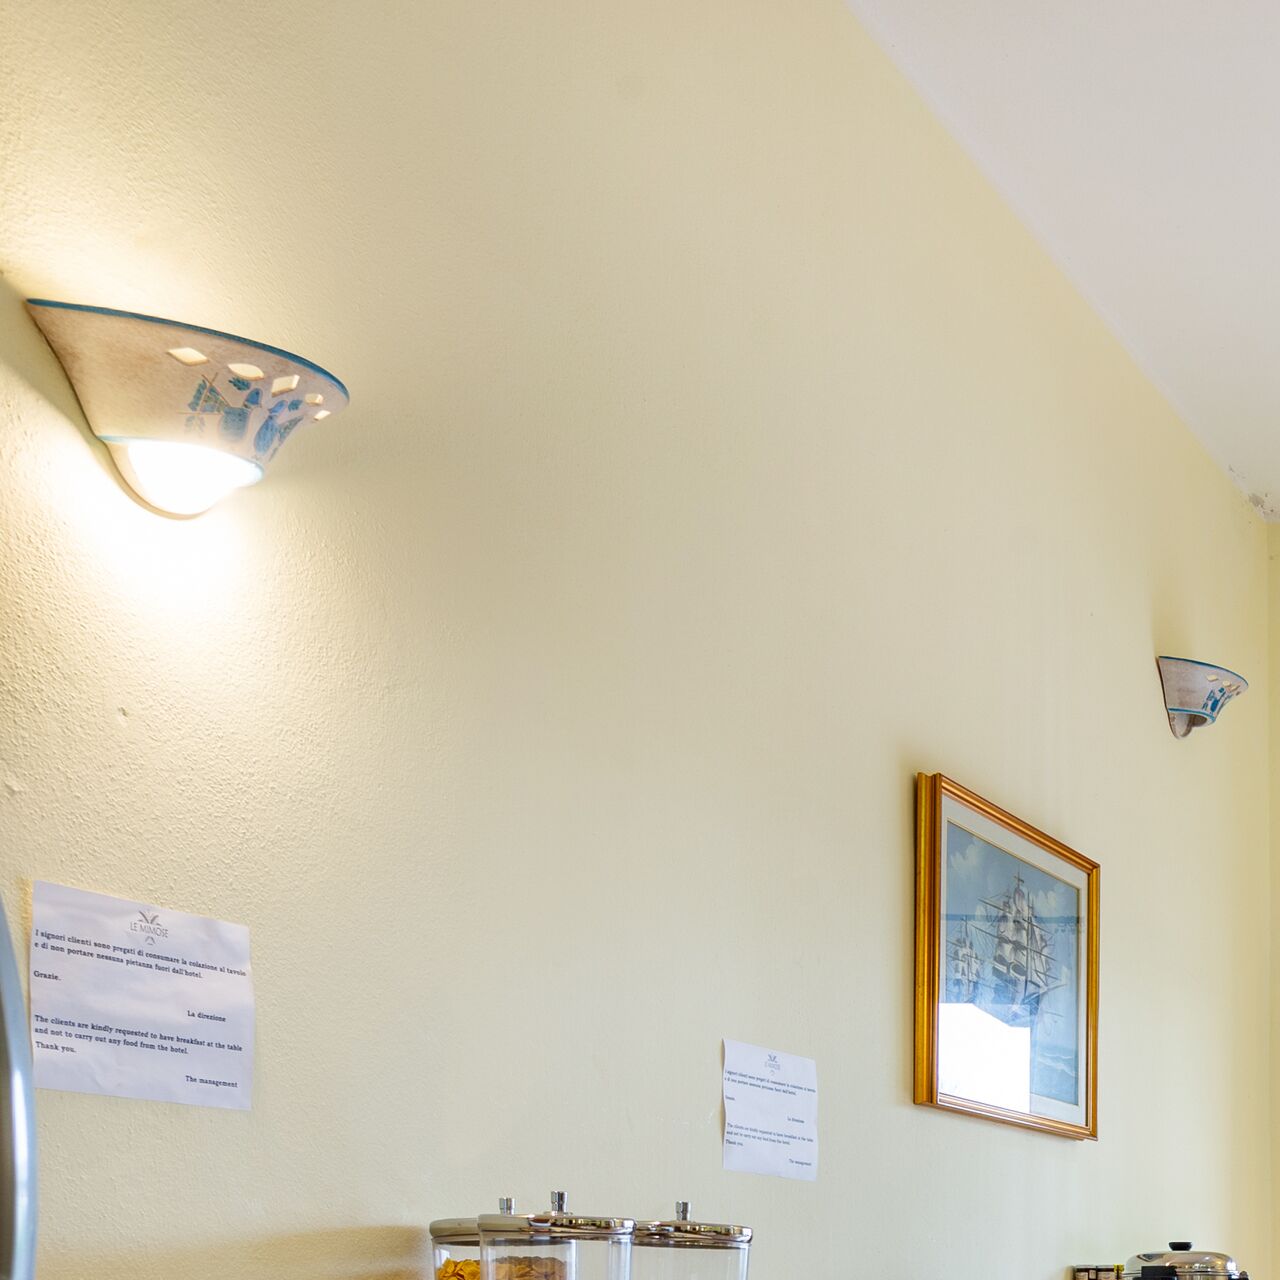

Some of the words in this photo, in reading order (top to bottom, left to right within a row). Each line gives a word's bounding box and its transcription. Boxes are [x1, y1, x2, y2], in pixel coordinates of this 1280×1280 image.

[130, 921, 138, 931] LE
[140, 923, 168, 938] MIMOSE
[40, 931, 66, 941] signori
[67, 936, 92, 946] clienti
[94, 942, 111, 950] sono
[113, 945, 136, 955] pregati
[145, 952, 180, 964] consumare
[189, 961, 218, 971] colazione
[227, 968, 247, 977] tavolo
[41, 942, 49, 950] di
[67, 947, 94, 958] portare
[96, 953, 124, 963] nessuna
[126, 959, 153, 969] pietanza
[155, 963, 170, 973] fuori
[33, 970, 62, 981] Grazie.
[197, 1012, 226, 1022] direzione
[34, 1014, 48, 1023] The
[50, 1017, 76, 1027] clients
[91, 1023, 113, 1034] kindly
[115, 1027, 149, 1038] requested
[159, 1033, 174, 1042] have
[176, 1036, 205, 1046] breakfast
[34, 1027, 48, 1035] and
[50, 1029, 63, 1037] not
[74, 1033, 93, 1042] carry
[108, 1038, 121, 1046] any
[123, 1038, 138, 1047] food
[140, 1041, 155, 1050] from
[157, 1043, 168, 1052] the
[35, 1041, 59, 1050] Thank
[61, 1045, 77, 1053] you.
[185, 1075, 197, 1083] The
[199, 1078, 238, 1088] management
